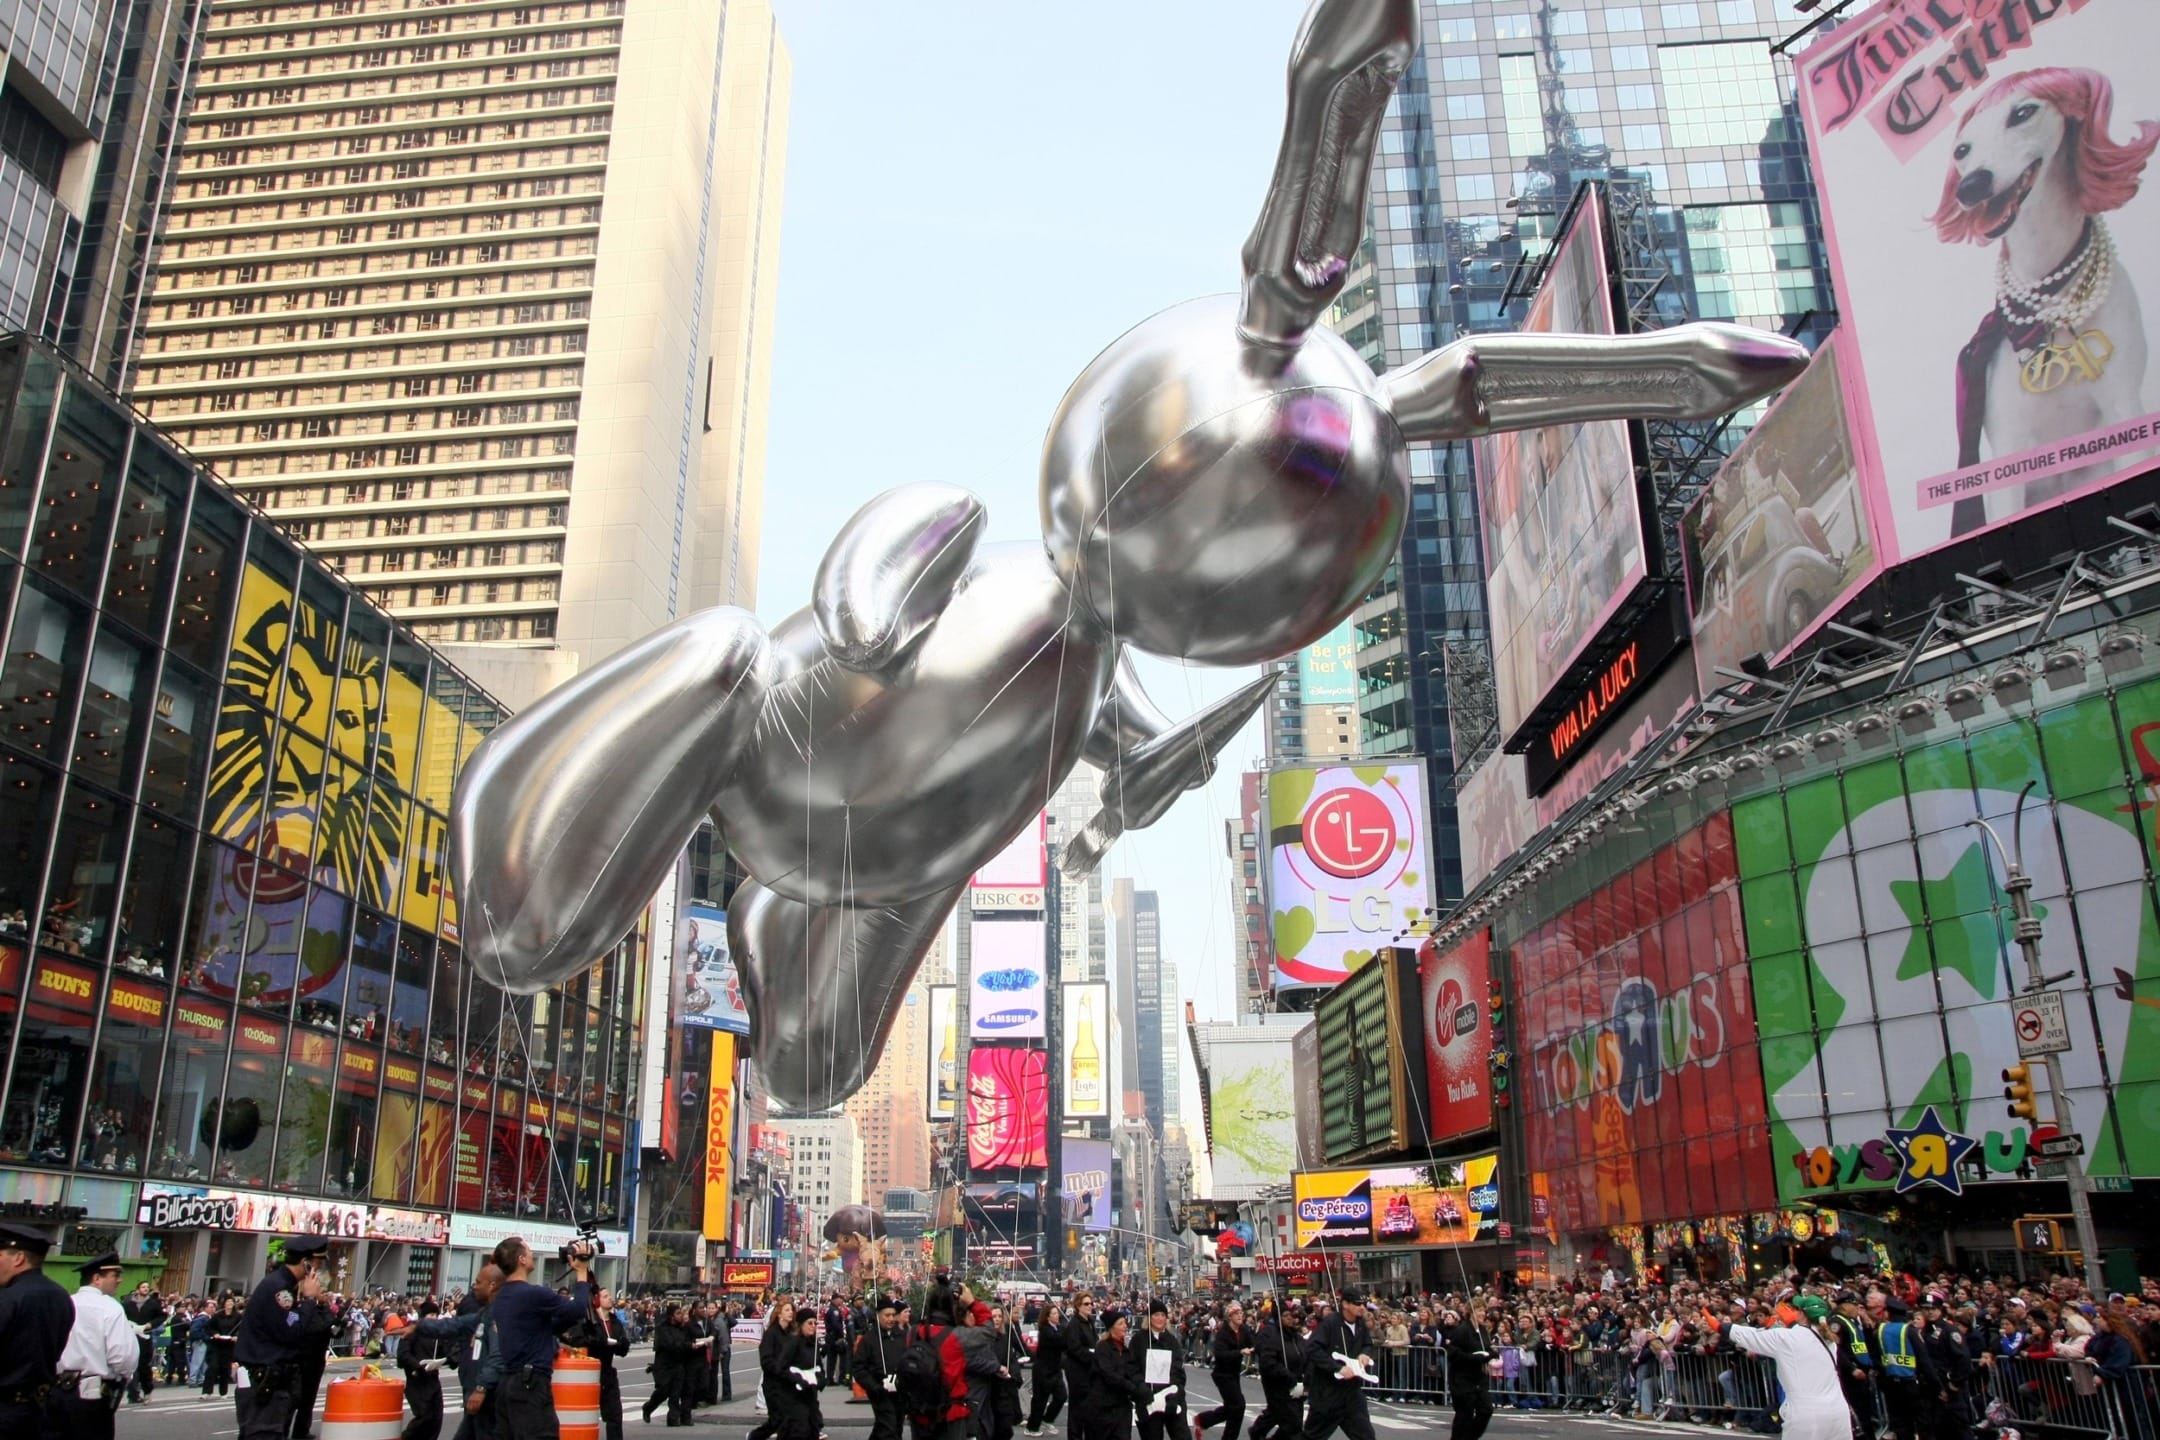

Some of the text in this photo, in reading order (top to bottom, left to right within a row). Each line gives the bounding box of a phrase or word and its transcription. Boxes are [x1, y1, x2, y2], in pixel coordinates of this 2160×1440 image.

[1927, 482, 1951, 500] THE
[1954, 470, 1991, 492] FIRST
[1994, 452, 2056, 481] COUTURE
[2059, 424, 2149, 463] FRAGRANCE
[1309, 658, 1337, 672] her
[1550, 710, 1580, 760] VIVA
[1580, 690, 1598, 731] LA
[1600, 641, 1636, 711] JUICY
[975, 893, 1017, 905] HSBC
[1314, 886, 1392, 933] LG
[40, 968, 92, 998] RUN'S
[112, 988, 162, 1016] HOUSE
[2043, 994, 2060, 1005] AREA
[178, 1007, 225, 1031] THURSDAY
[984, 1014, 1032, 1024] SAMSUNG
[1438, 985, 1457, 1041] Virgin
[1457, 1010, 1477, 1031] mobile
[243, 1026, 276, 1046] 10:00pm
[2046, 1029, 2064, 1040] OVER
[344, 1052, 375, 1073] RUN'S
[386, 1064, 418, 1084] HOUSE
[1447, 1078, 1479, 1104] You Rule.
[707, 1087, 729, 1185] Kodak
[1792, 1139, 1897, 1189] TOYS
[154, 1196, 238, 1231] Billabong
[466, 1223, 497, 1240] Enhanced
